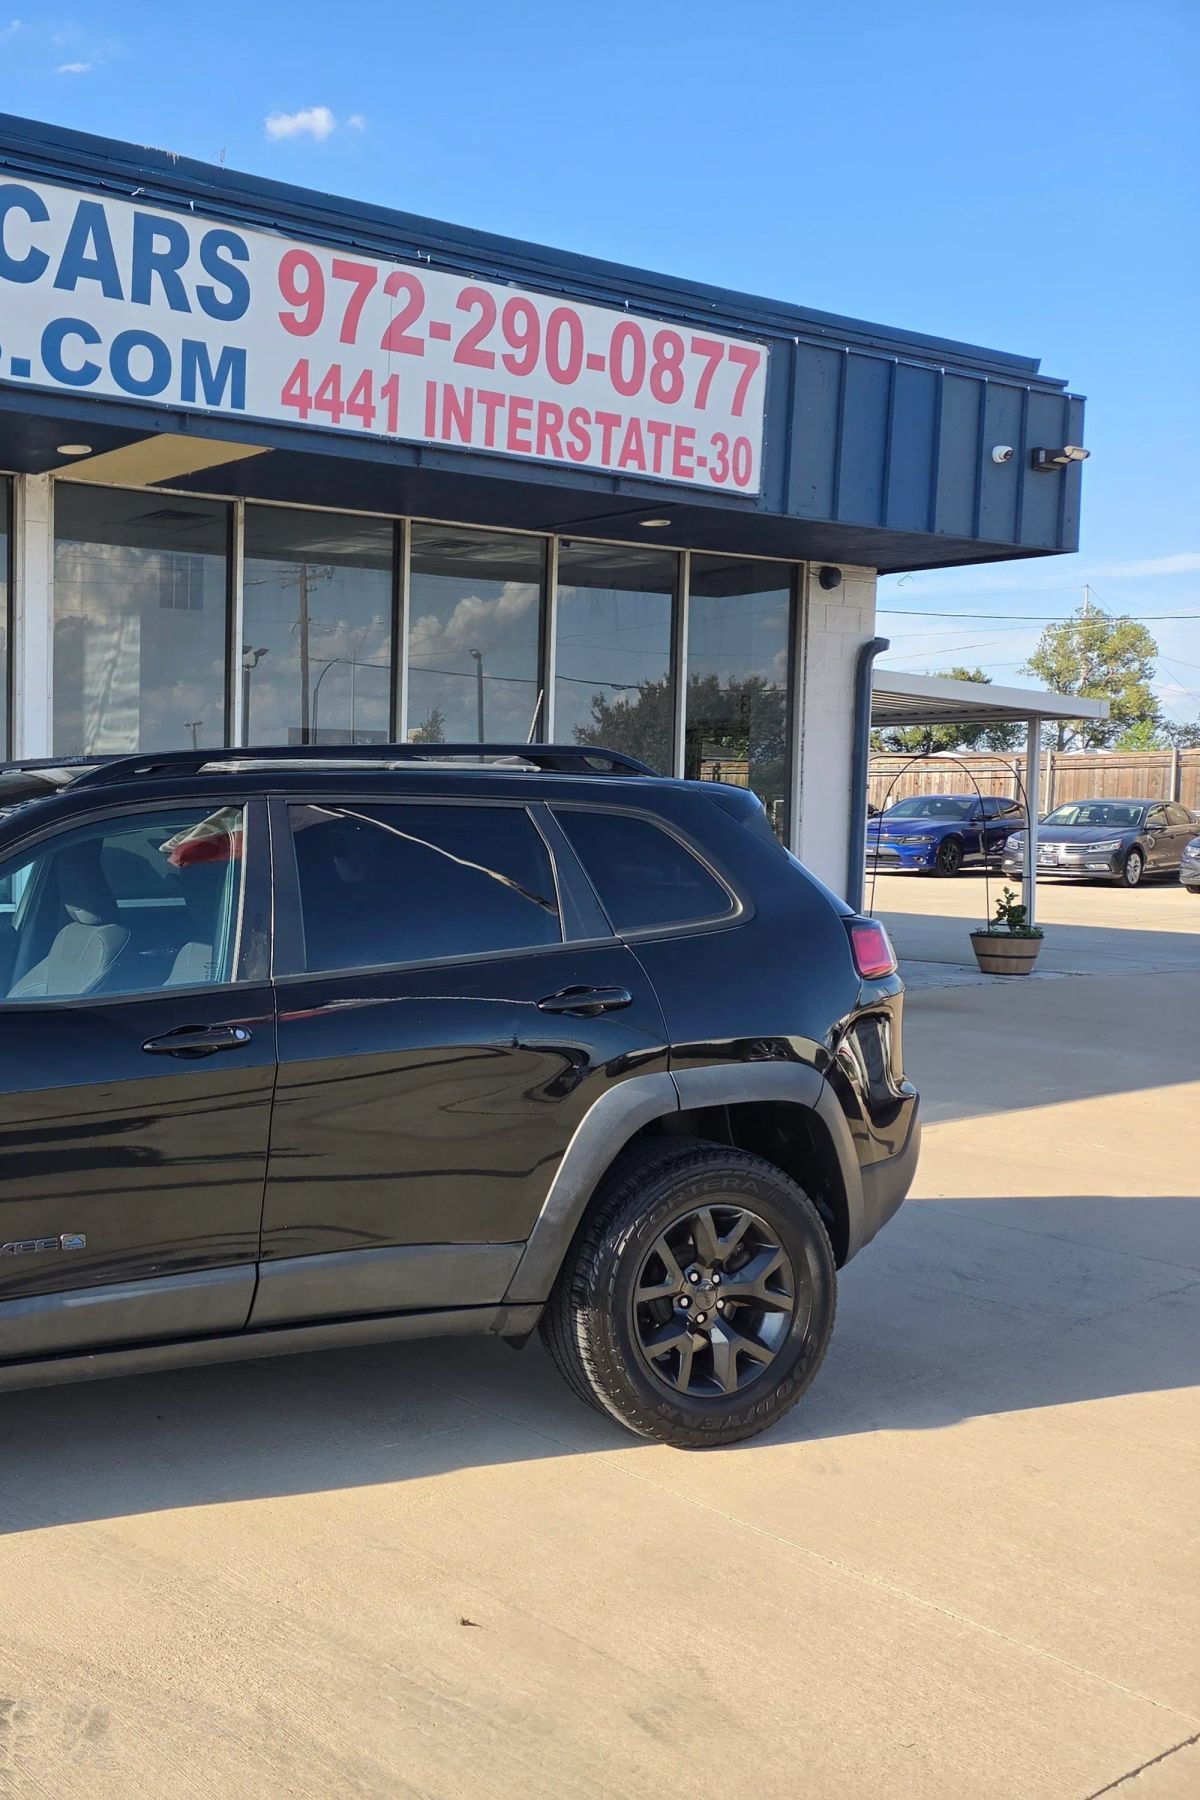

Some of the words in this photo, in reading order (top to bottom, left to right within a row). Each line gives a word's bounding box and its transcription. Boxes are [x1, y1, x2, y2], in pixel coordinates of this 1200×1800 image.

[277, 248, 761, 417] 972-290-0877
[280, 358, 399, 433] 4441
[424, 380, 753, 487] INTERSTATE-30
